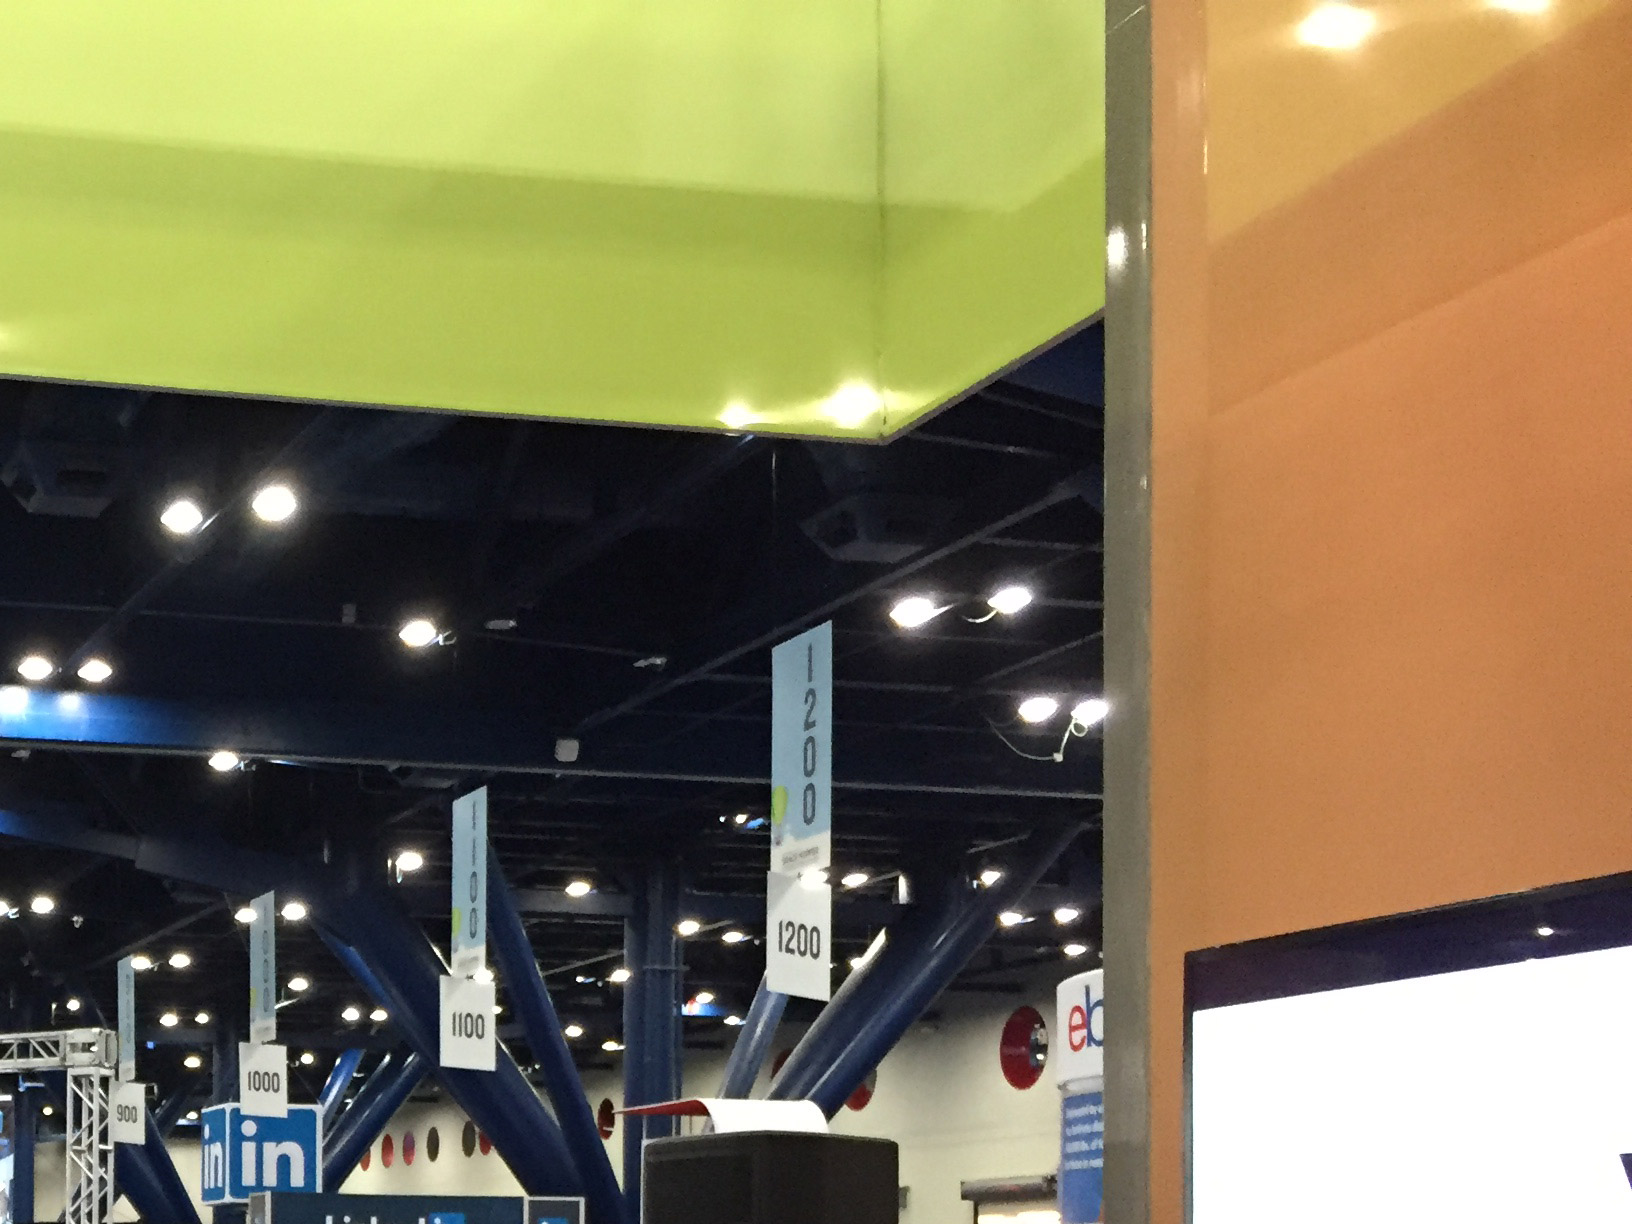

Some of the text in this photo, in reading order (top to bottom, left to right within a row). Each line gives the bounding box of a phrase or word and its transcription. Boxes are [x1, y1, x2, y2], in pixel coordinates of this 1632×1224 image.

[802, 642, 817, 826] 1200
[778, 920, 821, 960] 1200
[452, 1011, 485, 1040] 1100
[248, 1070, 280, 1093] 1000
[117, 1104, 138, 1124] 900
[203, 1123, 223, 1190] in
[241, 1119, 305, 1188] in
